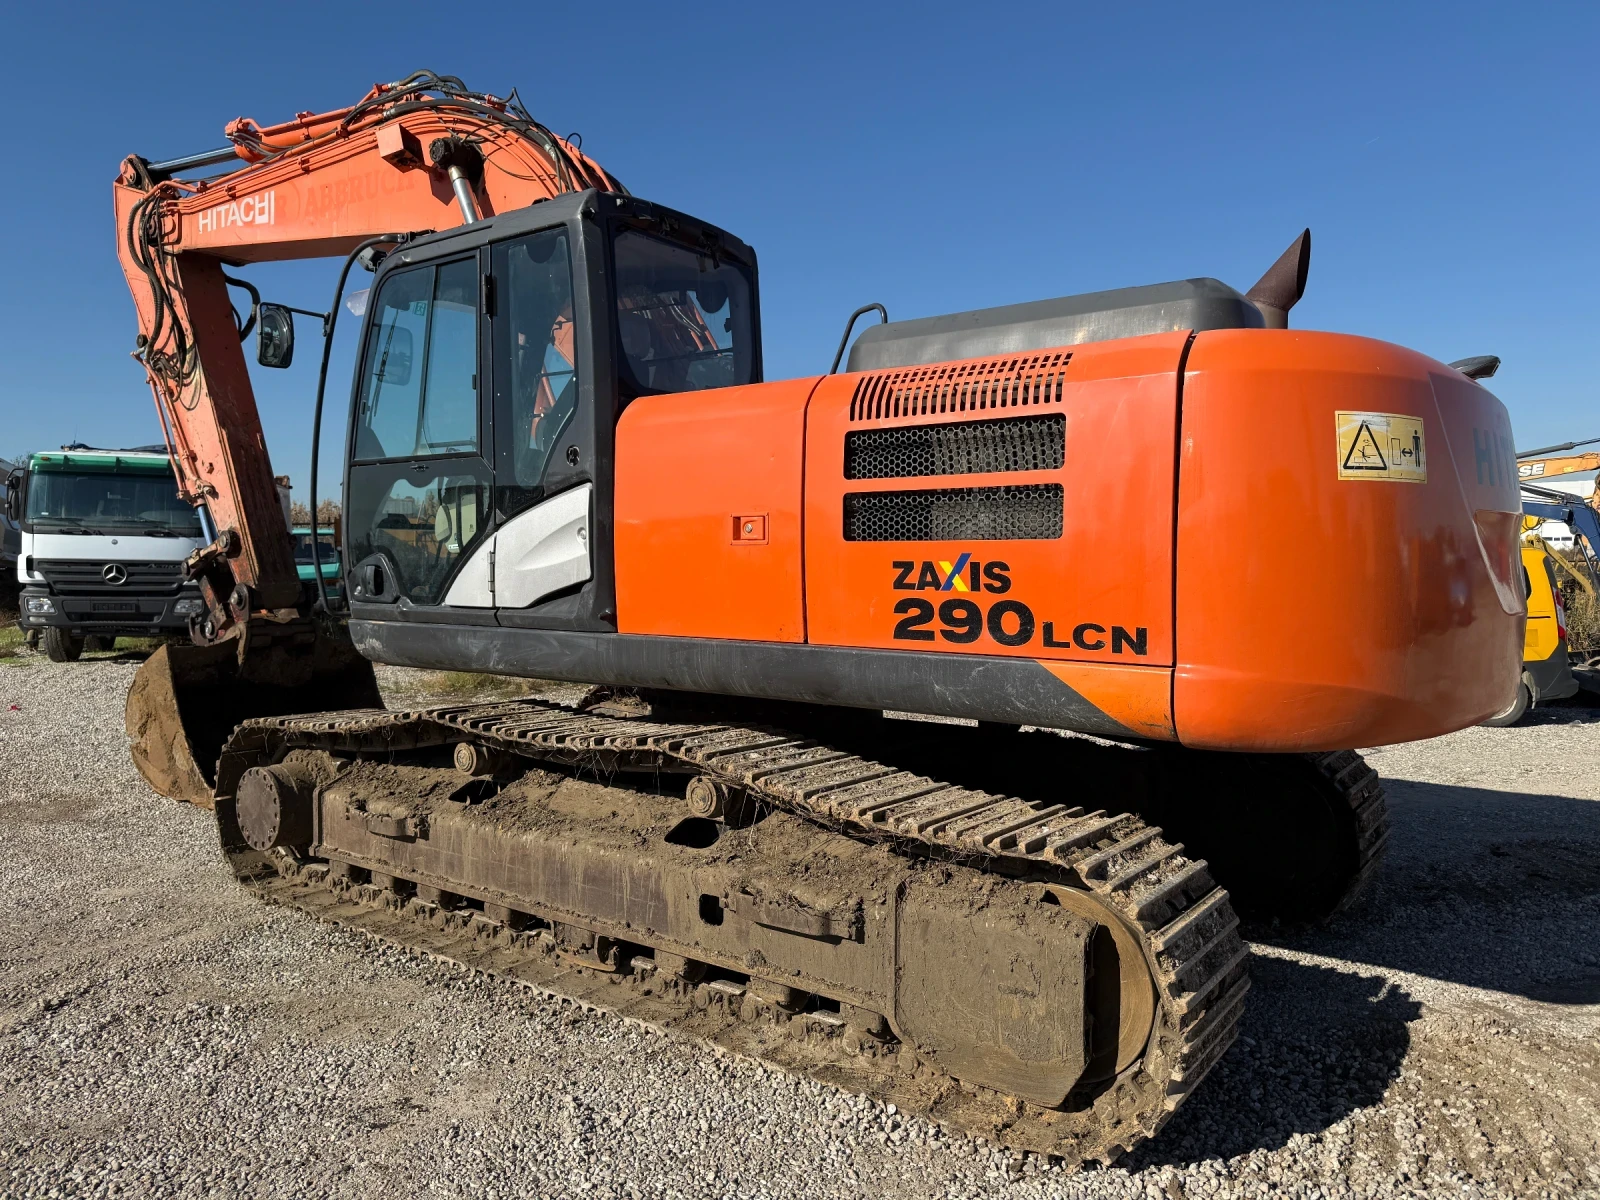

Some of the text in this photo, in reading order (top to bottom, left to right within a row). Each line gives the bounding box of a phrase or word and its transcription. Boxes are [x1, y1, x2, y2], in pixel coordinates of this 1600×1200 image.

[198, 190, 275, 234] HITACHI
[892, 552, 1012, 595] ZAXIS
[893, 597, 1148, 656] 290 LCN
